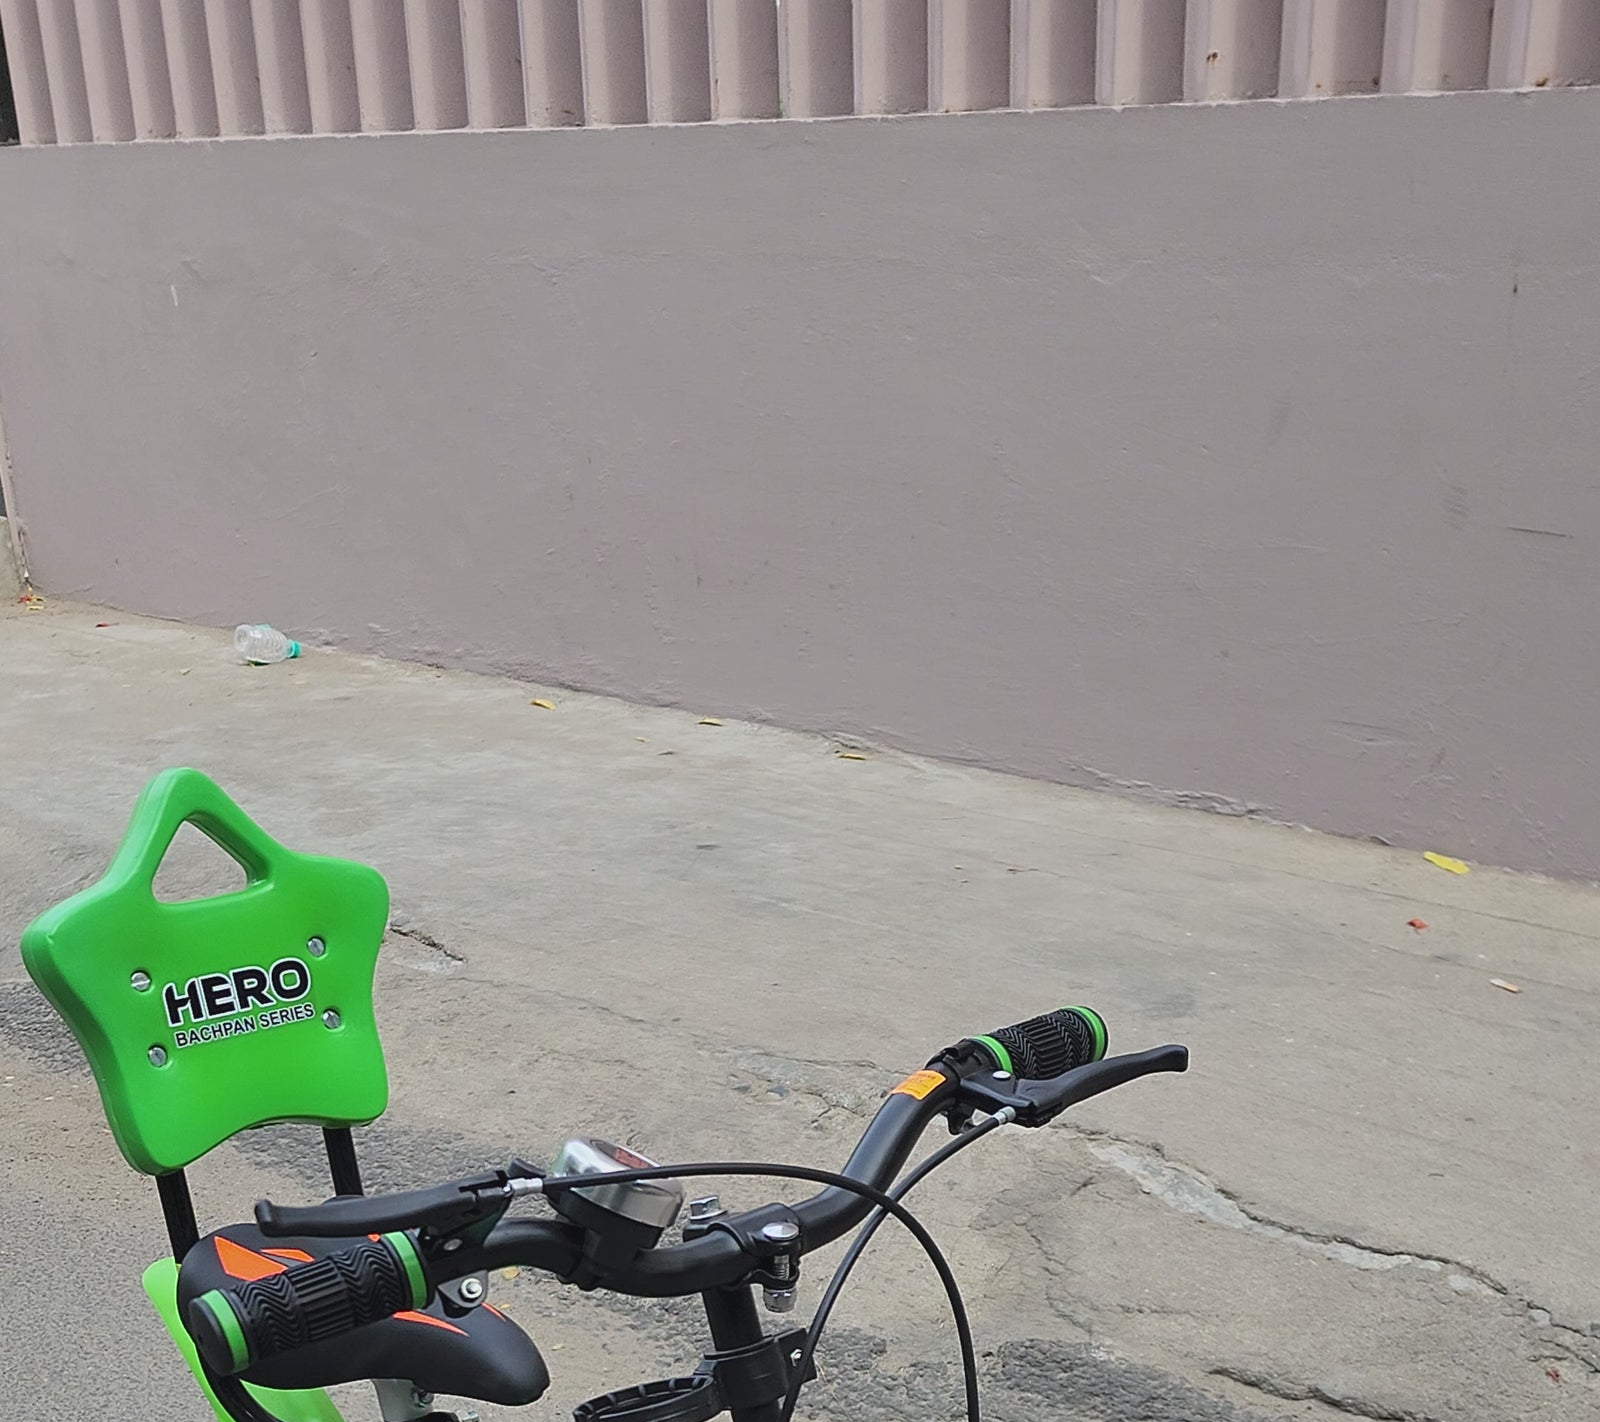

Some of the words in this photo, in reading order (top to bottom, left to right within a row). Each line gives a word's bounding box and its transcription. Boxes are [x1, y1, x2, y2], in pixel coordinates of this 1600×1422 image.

[163, 959, 311, 1026] HERO
[175, 1016, 256, 1047] BACHPAN
[258, 1003, 315, 1028] SERIES
